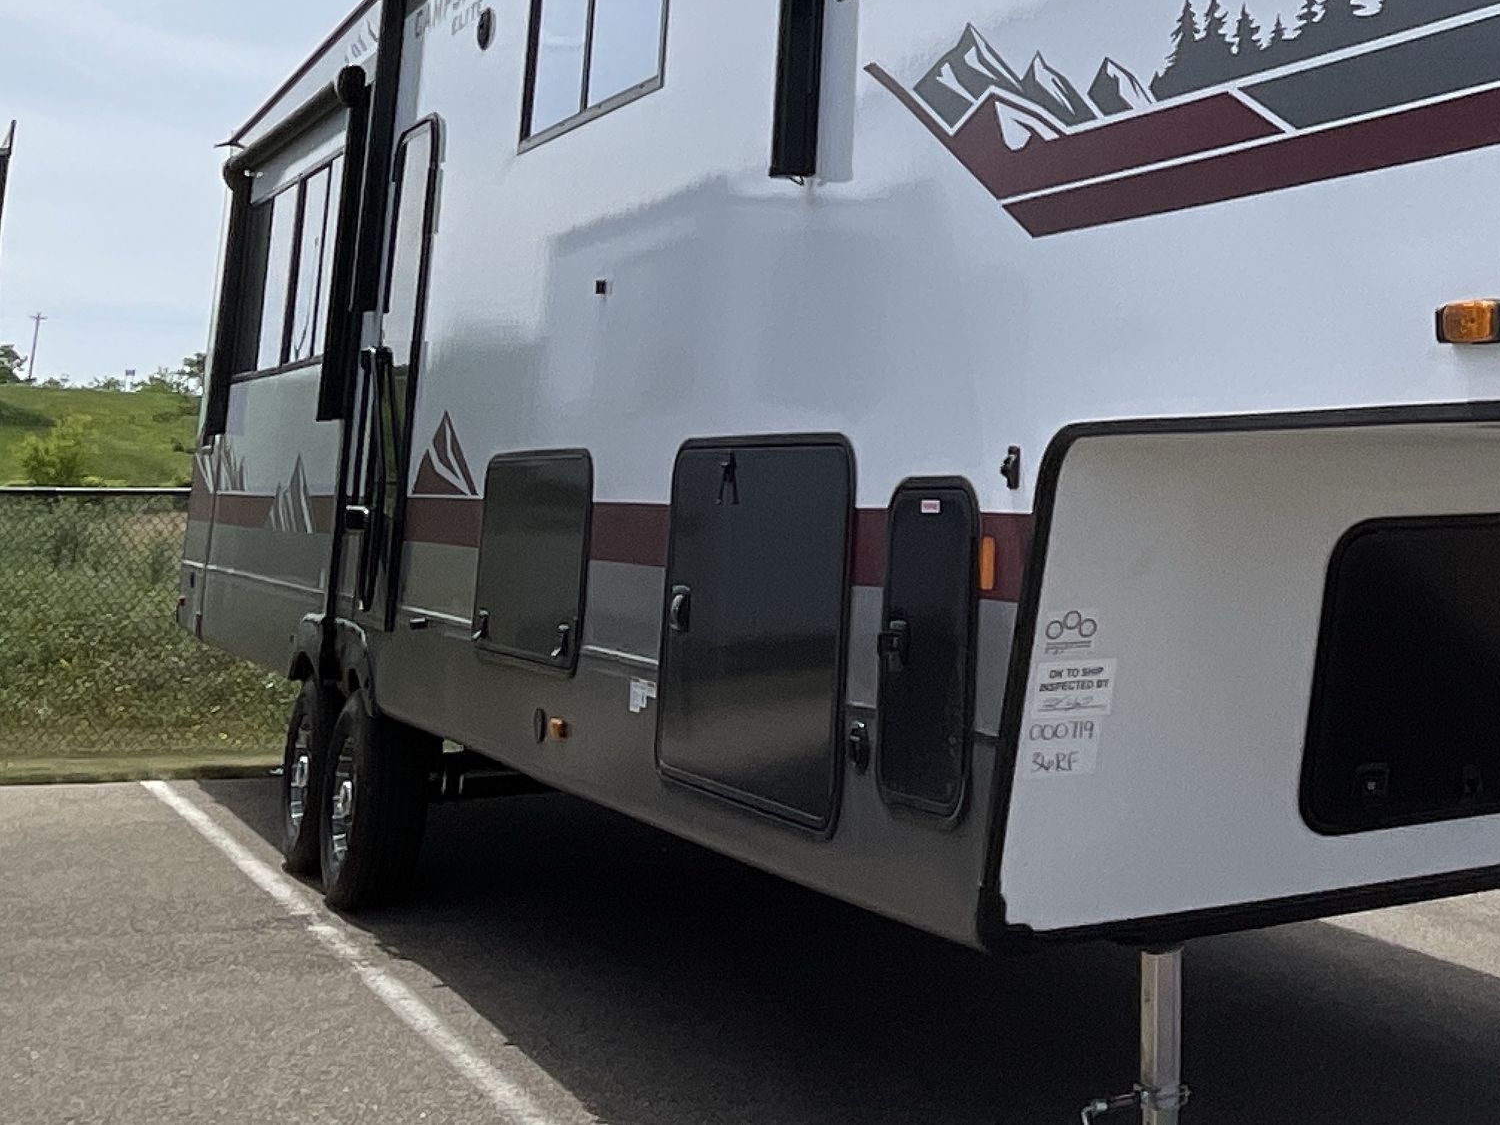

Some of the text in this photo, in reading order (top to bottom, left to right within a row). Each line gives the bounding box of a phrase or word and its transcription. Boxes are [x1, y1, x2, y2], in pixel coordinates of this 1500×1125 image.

[1066, 667, 1080, 679] TO
[1038, 678, 1110, 693] INSPECTED BY
